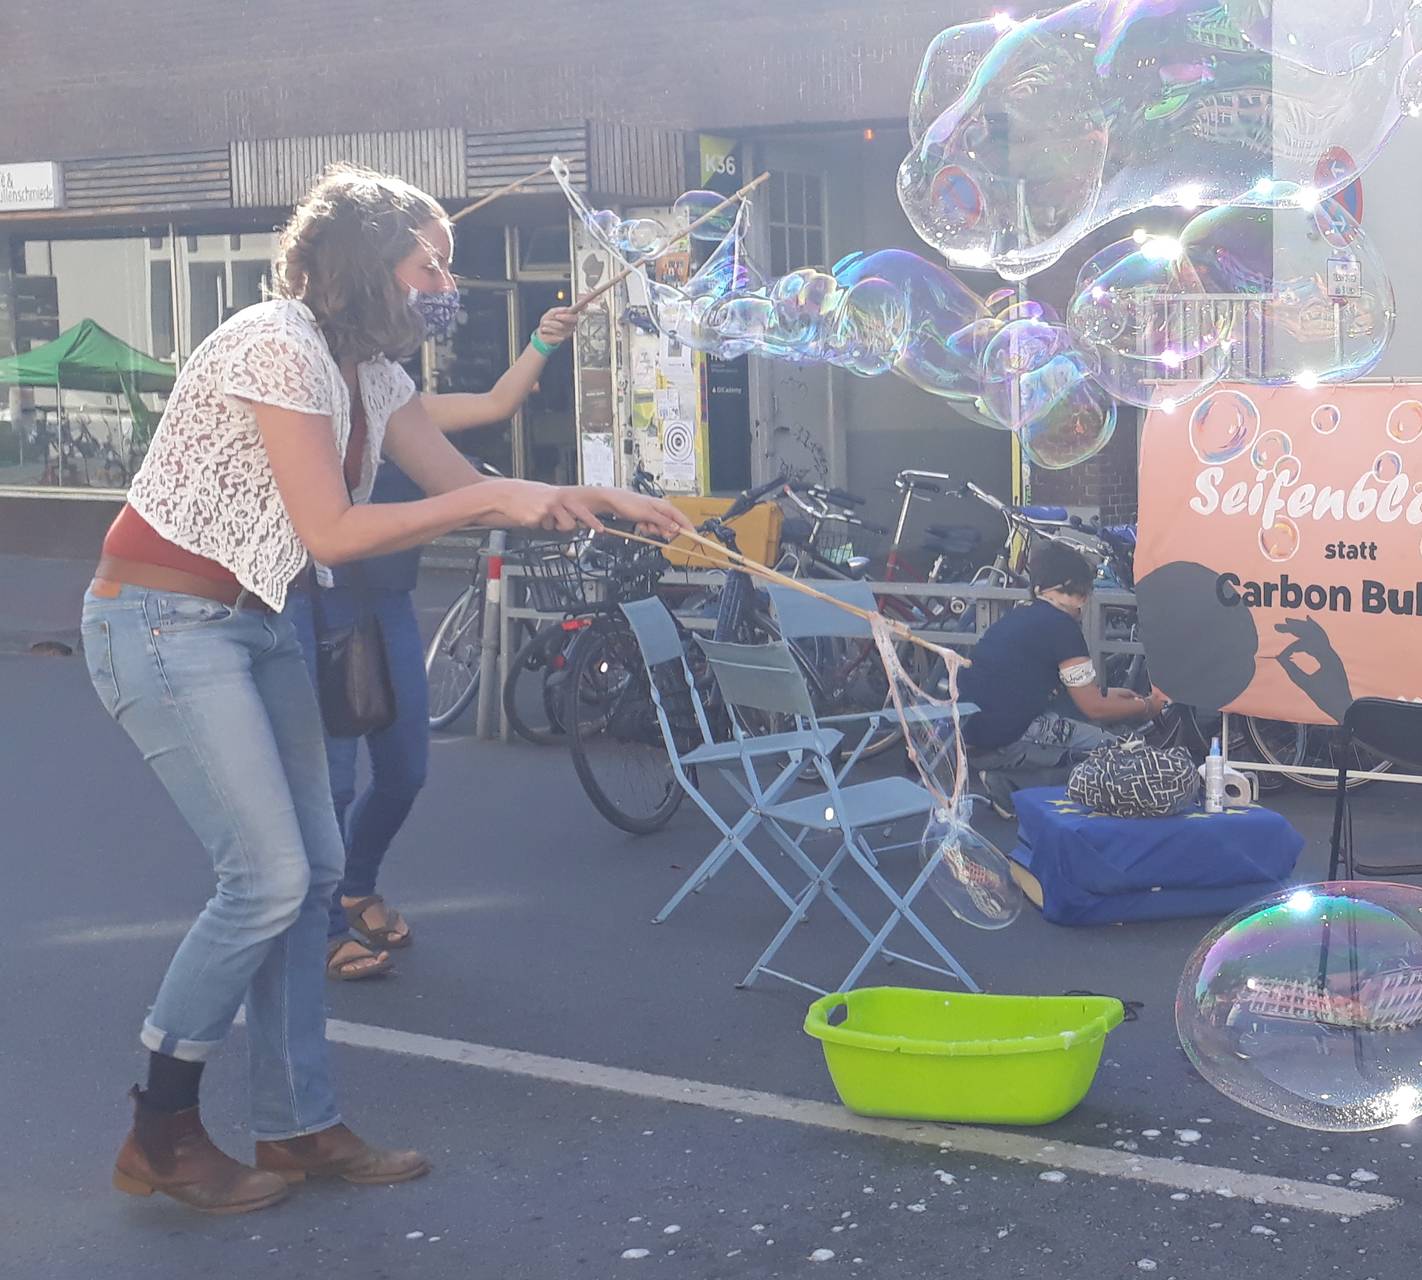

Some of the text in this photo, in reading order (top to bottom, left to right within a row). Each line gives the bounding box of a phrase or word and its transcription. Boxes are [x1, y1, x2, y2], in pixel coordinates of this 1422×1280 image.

[705, 153, 736, 176] K36
[1324, 541, 1378, 561] statt
[1215, 572, 1352, 613] Carbon
